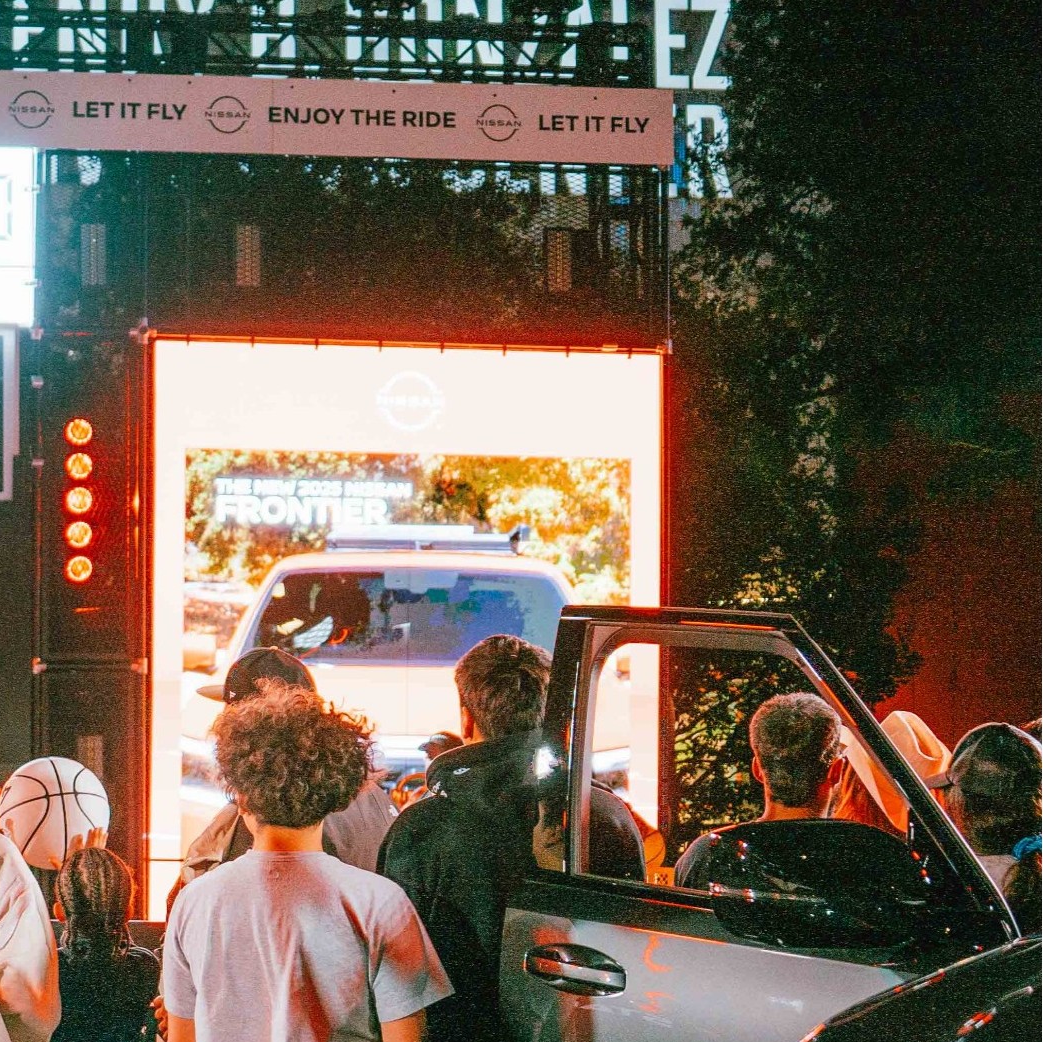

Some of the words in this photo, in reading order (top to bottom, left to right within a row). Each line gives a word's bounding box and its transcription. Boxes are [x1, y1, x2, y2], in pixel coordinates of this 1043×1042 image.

[7, 105, 56, 114] NISSAN
[72, 101, 115, 118] LET
[120, 102, 141, 119] IT
[147, 103, 187, 120] FLY
[204, 111, 252, 119] NISSAN
[268, 106, 346, 125] ENJOY
[350, 109, 396, 126] THE
[402, 110, 457, 128] RIDE
[476, 119, 522, 127] NISSAN
[538, 114, 579, 132] LET
[585, 115, 605, 132] IT
[611, 116, 650, 133] FLY
[215, 478, 252, 495] THE
[253, 479, 297, 496] NEW
[215, 495, 388, 525] FRONTIER
